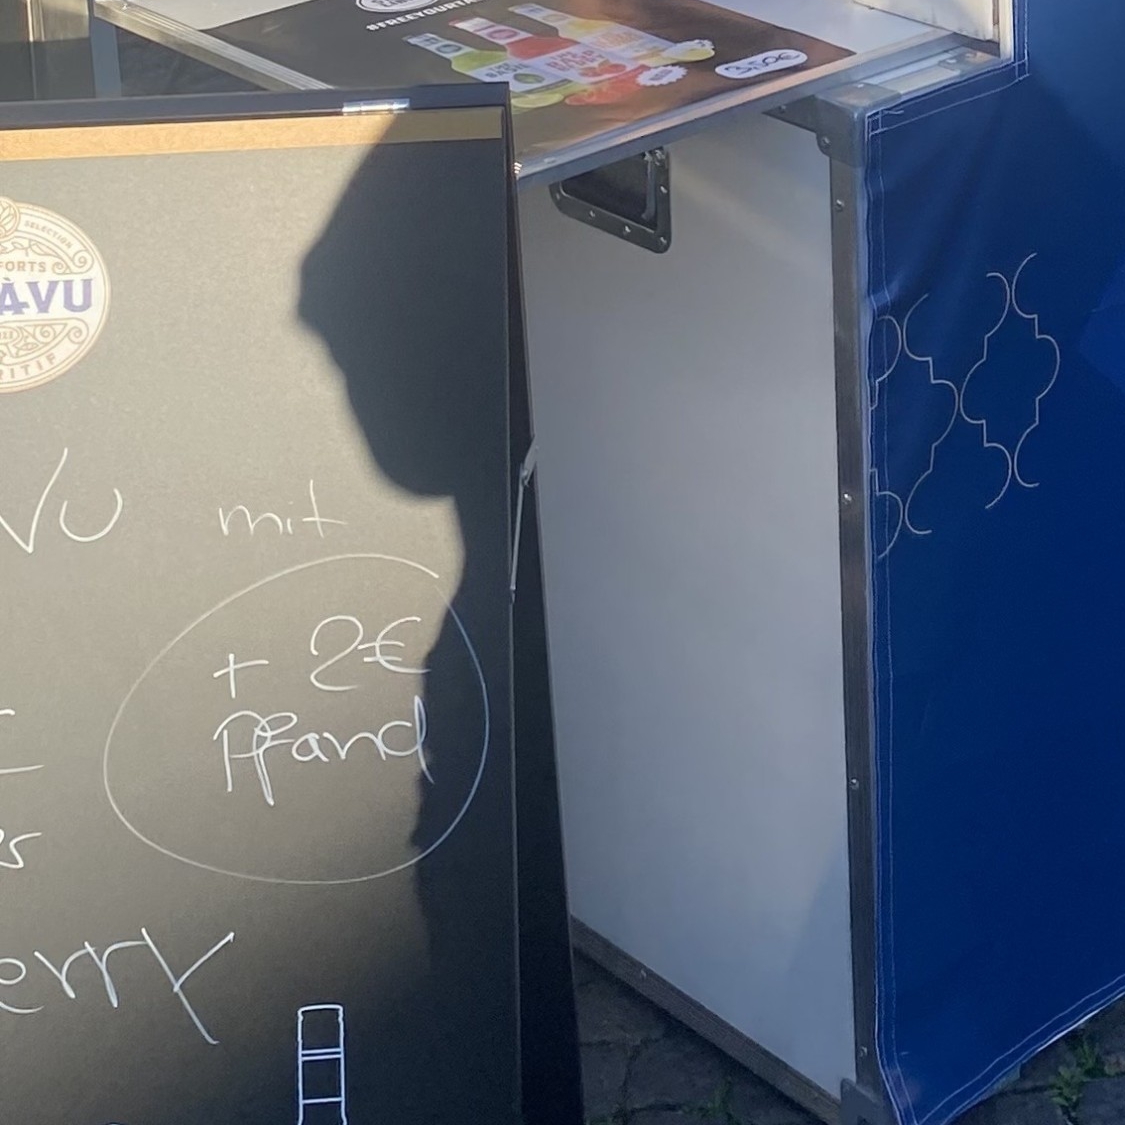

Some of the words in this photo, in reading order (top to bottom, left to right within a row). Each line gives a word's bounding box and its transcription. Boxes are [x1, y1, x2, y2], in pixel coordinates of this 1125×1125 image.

[724, 52, 800, 75] 3,50€
[24, 220, 73, 250] SELECTION
[219, 479, 348, 538] mit
[309, 615, 431, 691] 2€
[213, 695, 435, 806] Pfand
